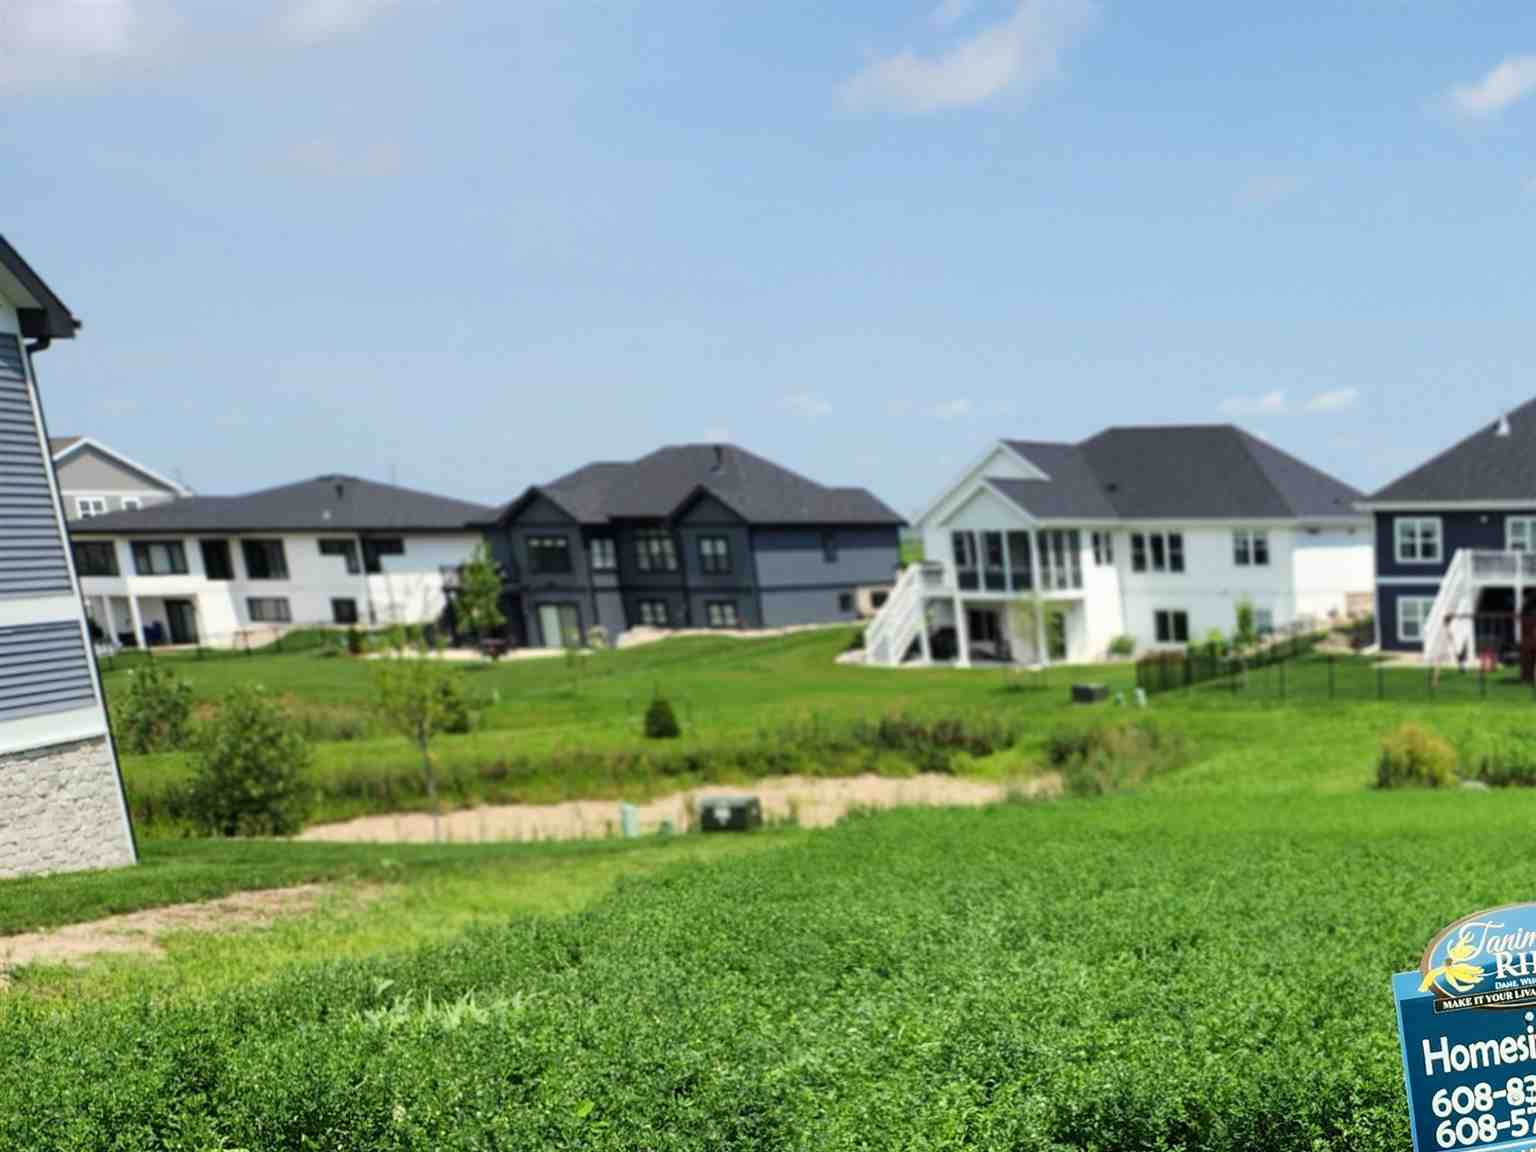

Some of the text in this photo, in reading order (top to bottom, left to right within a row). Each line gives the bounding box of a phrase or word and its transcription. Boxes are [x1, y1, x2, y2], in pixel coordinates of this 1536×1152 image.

[1442, 998, 1473, 1010] MAKE
[1474, 996, 1485, 1006] IT
[1485, 992, 1513, 1004] YOUR
